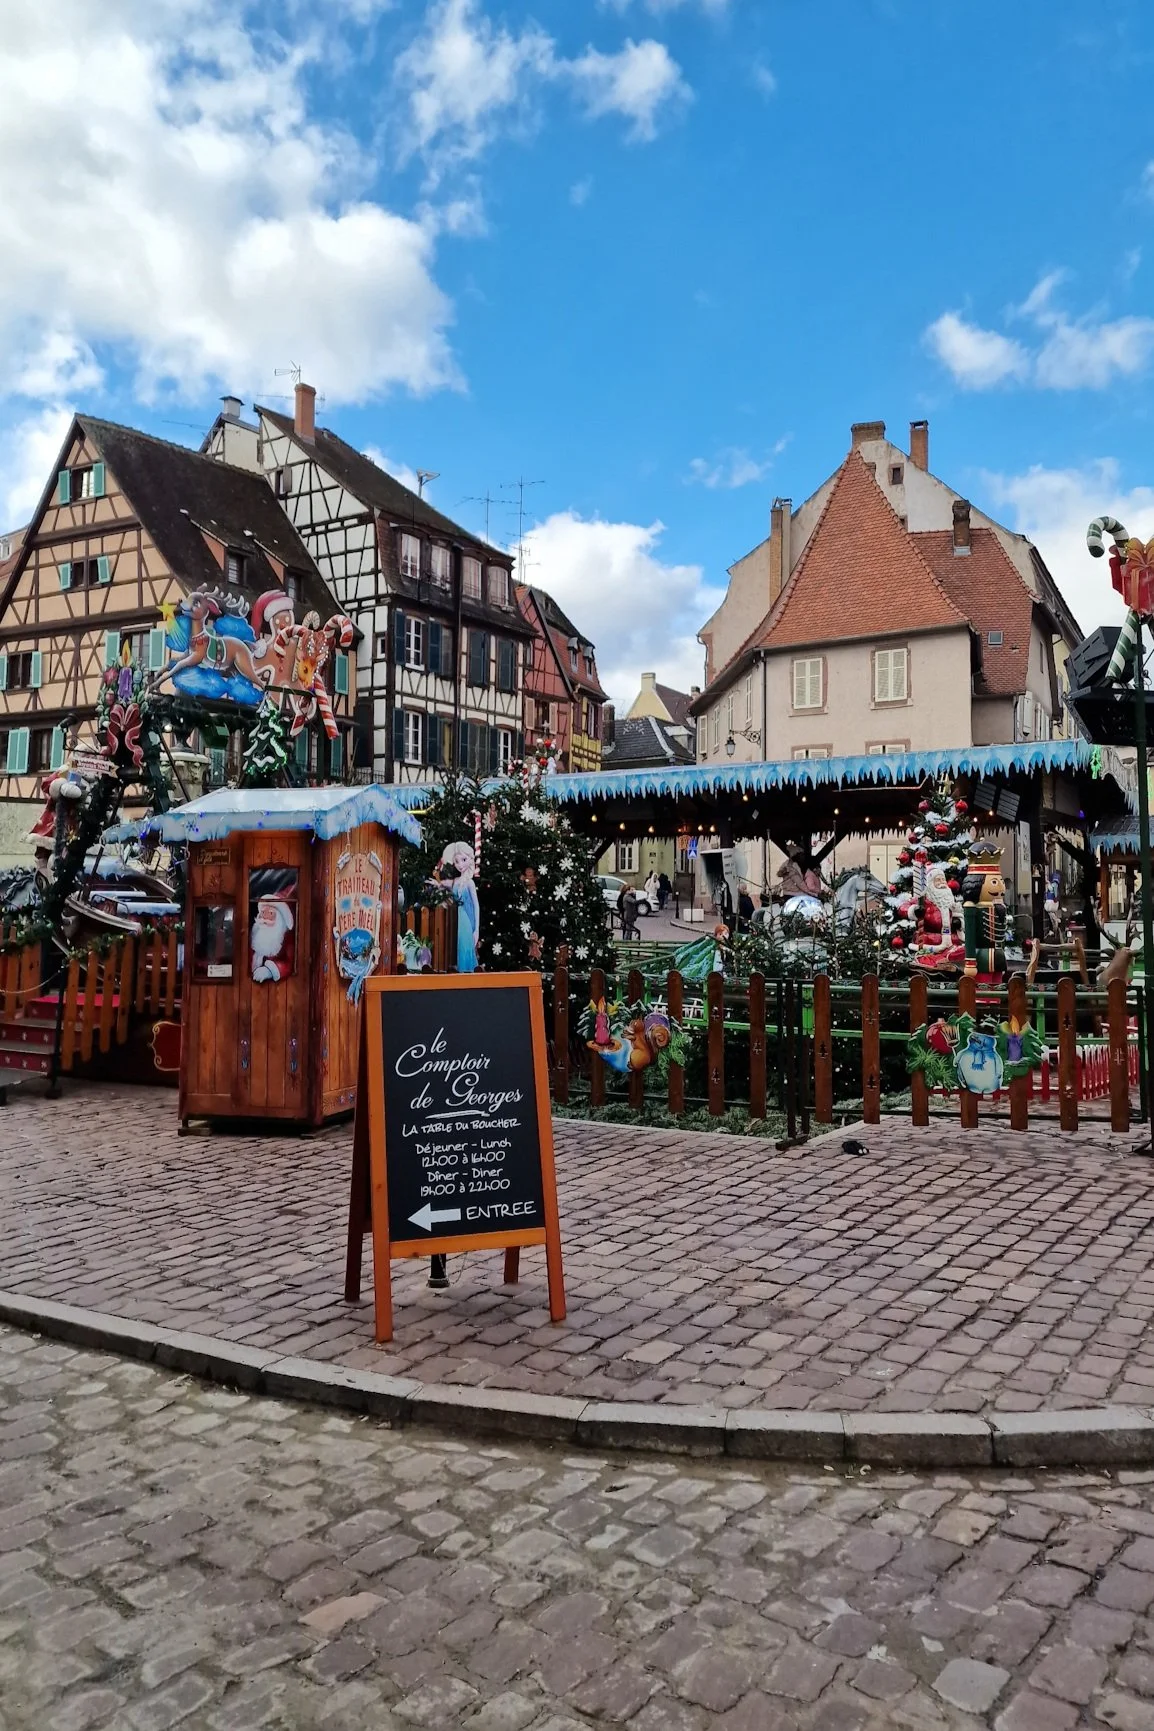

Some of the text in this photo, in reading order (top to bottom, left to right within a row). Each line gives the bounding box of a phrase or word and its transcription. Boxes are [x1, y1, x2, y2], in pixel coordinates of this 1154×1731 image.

[355, 859, 362, 872] LE
[430, 1027, 447, 1053] le
[410, 1072, 523, 1113] de Georges
[402, 1118, 521, 1137] LA TABLE DU BOUCHER
[415, 1142, 468, 1156] Déjeuner
[481, 1138, 511, 1149] Lunch
[422, 1151, 505, 1168] 12h00 à 16h00
[427, 1171, 459, 1182] Dîner
[472, 1168, 503, 1178] Diner
[421, 1179, 510, 1197] 19h00 à 22h00
[466, 1201, 536, 1220] ENTREE
